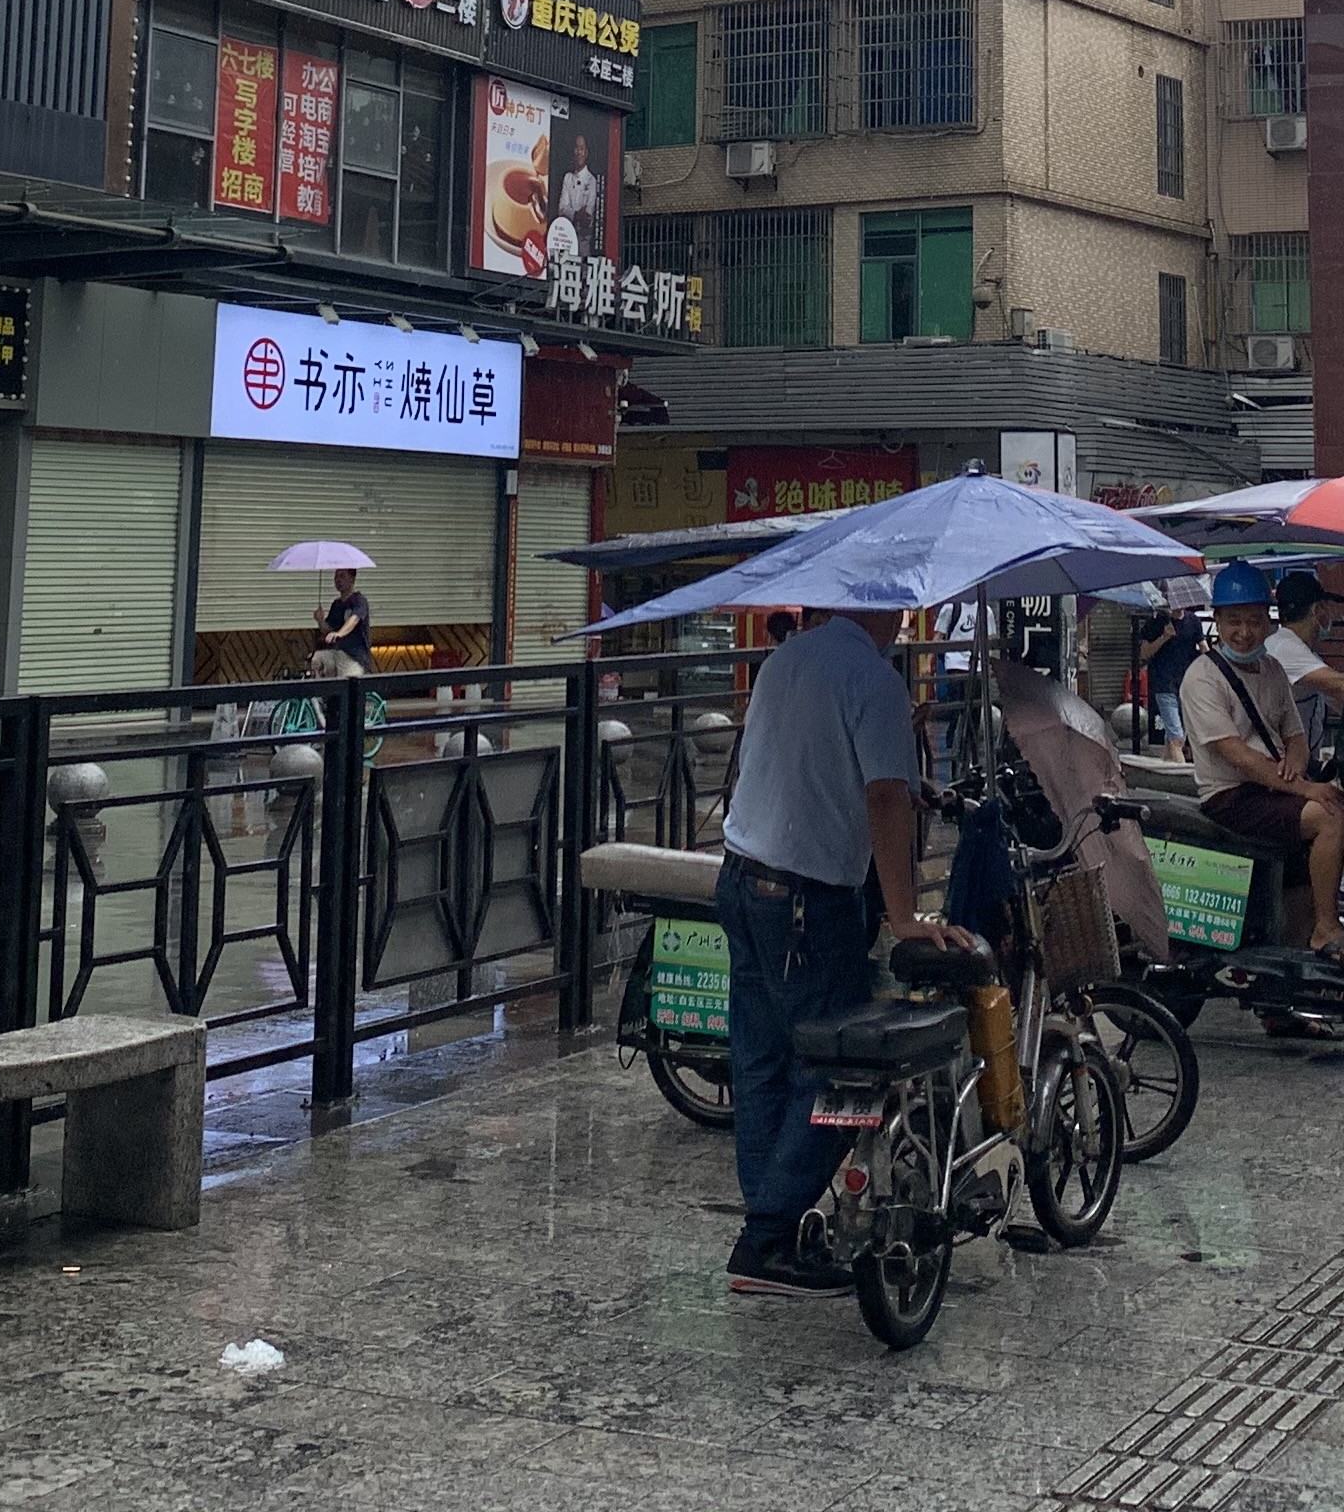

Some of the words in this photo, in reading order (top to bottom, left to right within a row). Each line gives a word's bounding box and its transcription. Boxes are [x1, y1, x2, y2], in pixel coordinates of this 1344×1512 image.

[221, 43, 275, 80] 六七楼
[302, 61, 336, 95] 办公
[588, 54, 634, 89] 本座二楼
[231, 78, 258, 168] 写字楼
[300, 93, 334, 125] 电商
[298, 122, 331, 155] 淘宝
[221, 167, 265, 204] 招商
[545, 250, 686, 330] 海雅会所
[293, 347, 366, 414] 书亦
[697, 971, 720, 990] 2235
